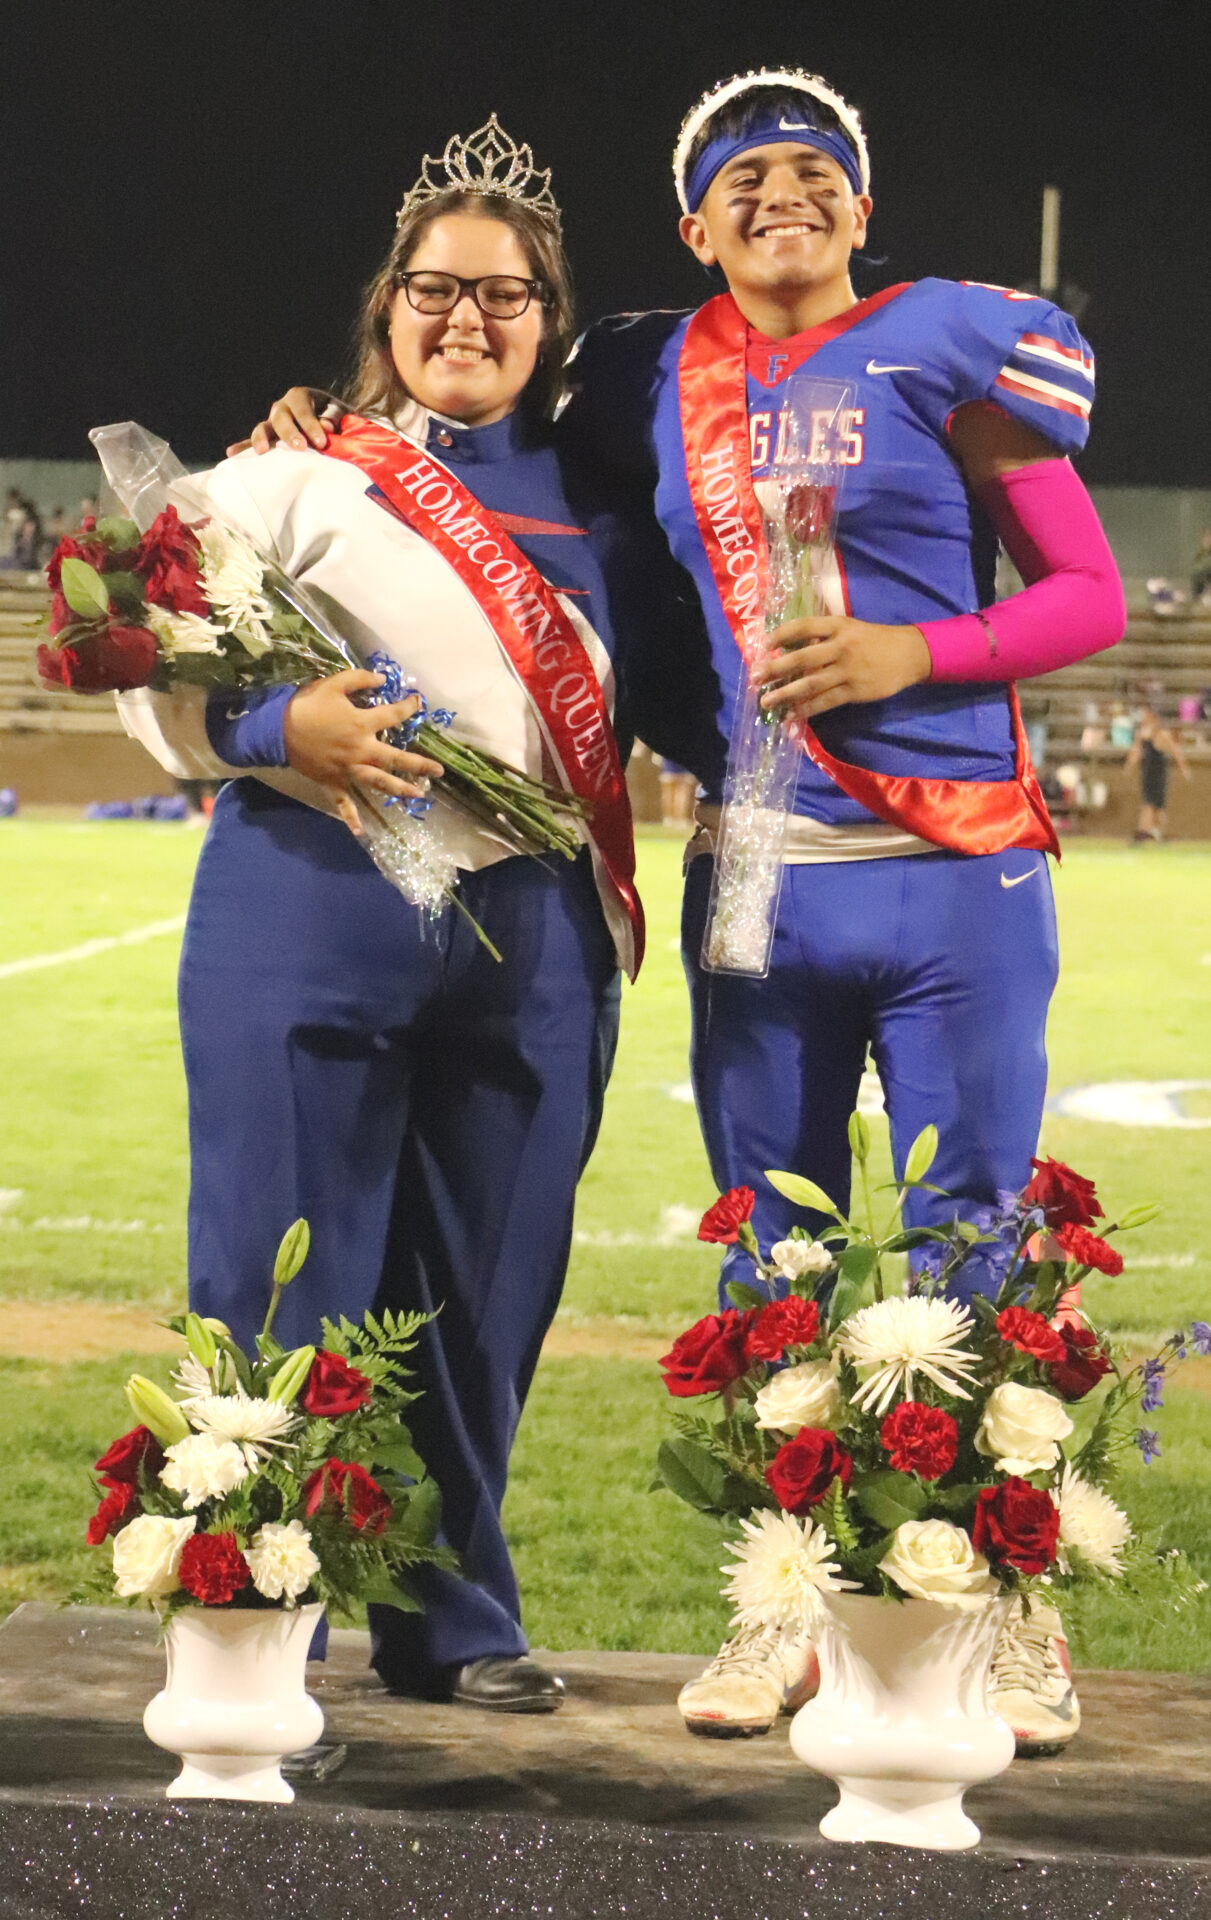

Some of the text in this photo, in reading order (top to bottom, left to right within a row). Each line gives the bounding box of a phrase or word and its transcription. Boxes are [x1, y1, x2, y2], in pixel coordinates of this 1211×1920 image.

[764, 353, 789, 384] F
[747, 408, 866, 467] GLES
[394, 457, 615, 793] HOMECOMING QUEEN
